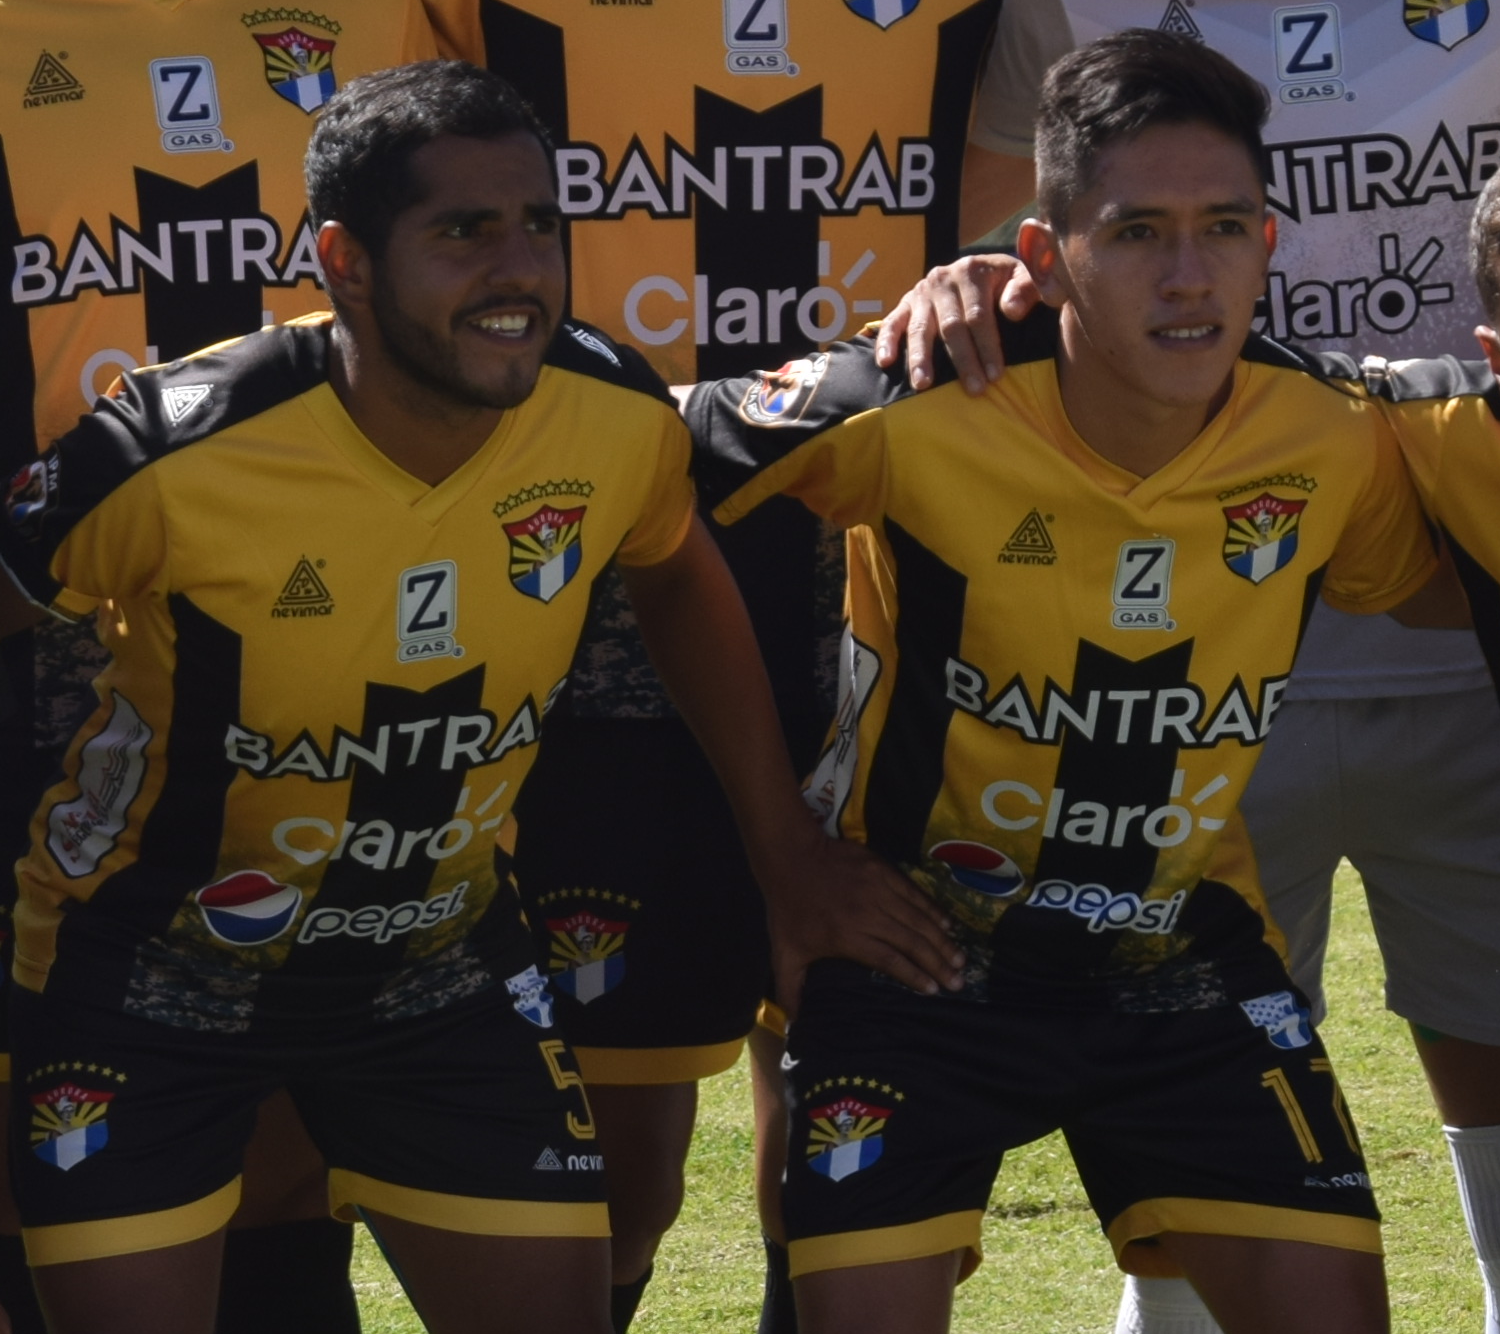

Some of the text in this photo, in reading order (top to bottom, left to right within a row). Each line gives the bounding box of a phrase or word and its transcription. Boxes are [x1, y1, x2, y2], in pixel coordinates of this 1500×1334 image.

[736, 56, 780, 68] GAS
[1281, 12, 1334, 75] Z
[23, 88, 86, 109] nevimar
[160, 65, 211, 122] Z
[1288, 83, 1336, 99] GAS
[170, 133, 214, 147] GAS
[557, 144, 935, 213] BANTRAB
[11, 219, 323, 305] BANTRA
[623, 273, 847, 346] Claro
[997, 551, 1058, 566] nevimar
[1120, 546, 1166, 599] Z
[270, 603, 336, 619] nevimar
[406, 569, 448, 634] Z
[1119, 612, 1159, 623] GAS
[405, 640, 446, 657] GAS
[981, 779, 1193, 848] Claro
[271, 816, 473, 870] Claro
[296, 880, 470, 944] pepsi
[1026, 878, 1188, 934] pepsi
